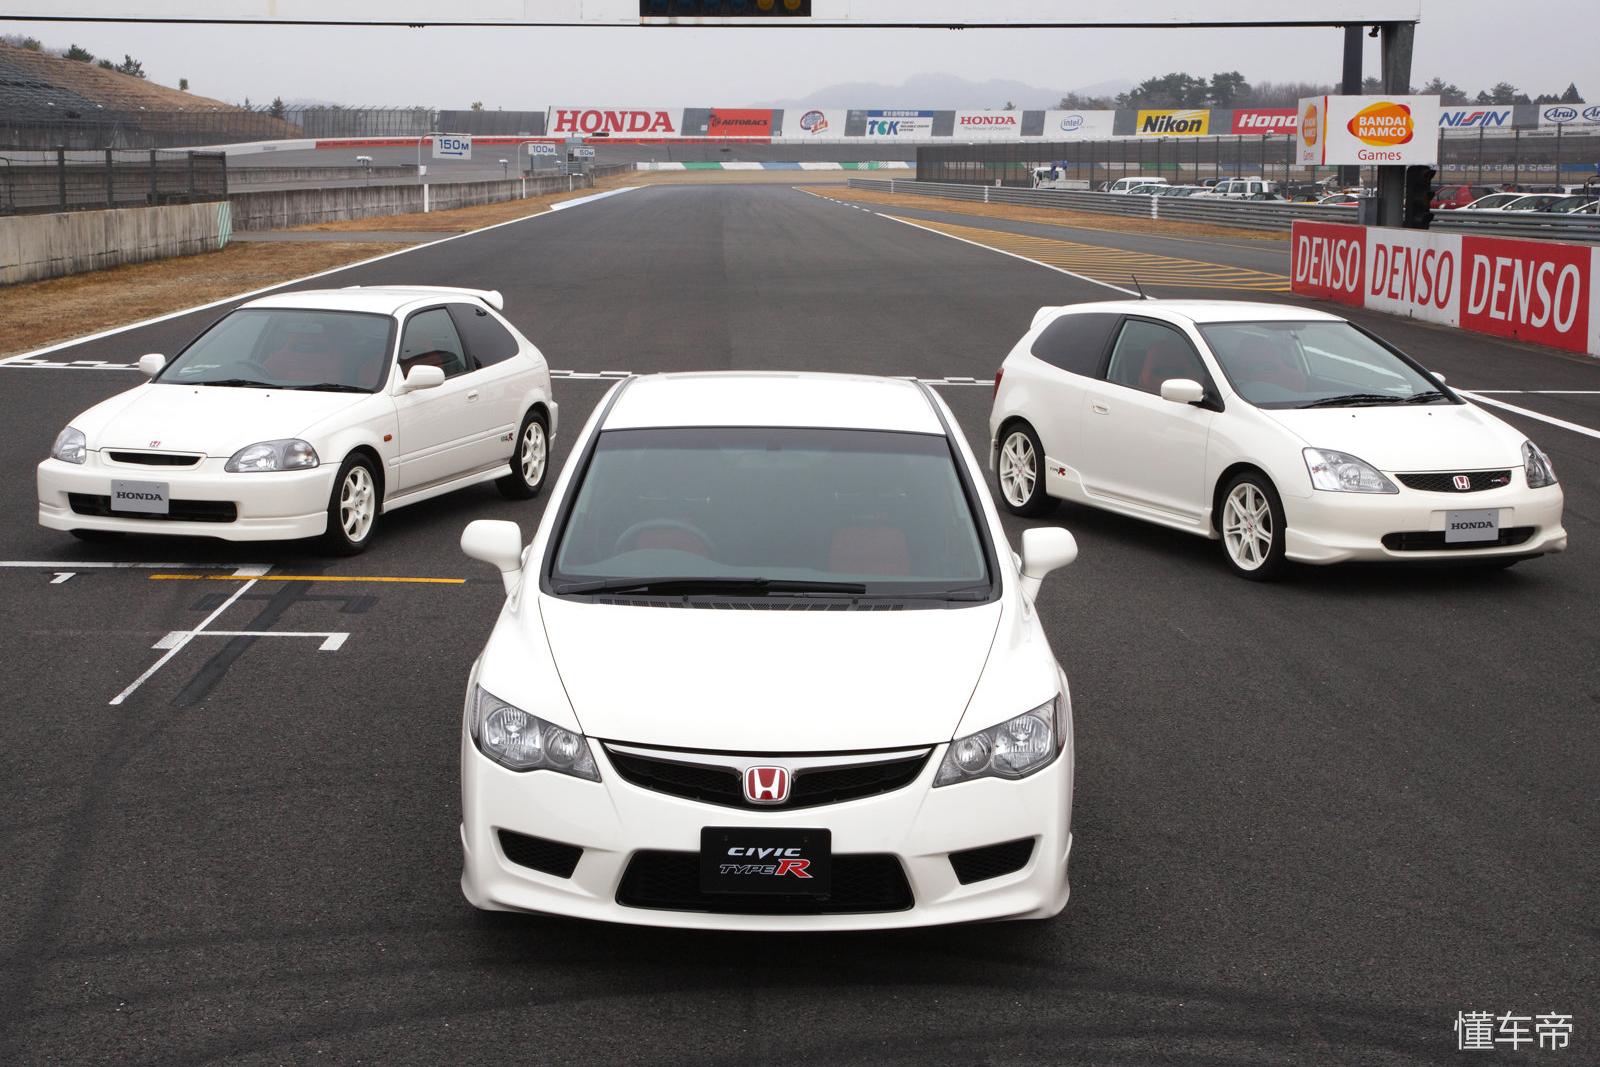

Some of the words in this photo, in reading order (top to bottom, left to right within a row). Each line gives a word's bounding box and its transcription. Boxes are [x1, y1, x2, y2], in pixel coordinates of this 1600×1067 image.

[1549, 108, 1573, 118] Arai
[554, 110, 675, 133] HONDA
[722, 119, 768, 127] AUTOBACS
[960, 116, 1016, 125] HONDA
[1063, 119, 1081, 127] intel
[1143, 115, 1202, 133] Nikon
[1359, 116, 1406, 126] BANDAI
[868, 120, 900, 136] TCK
[1358, 127, 1406, 137] NAMCO
[1358, 149, 1402, 161] Games
[1296, 236, 1361, 293] DENSO
[1371, 243, 1454, 310] DENSO
[1467, 254, 1580, 334] DENSO
[116, 491, 163, 501] HONDA
[1451, 521, 1494, 530] HONDA
[727, 847, 801, 859] CIVIC
